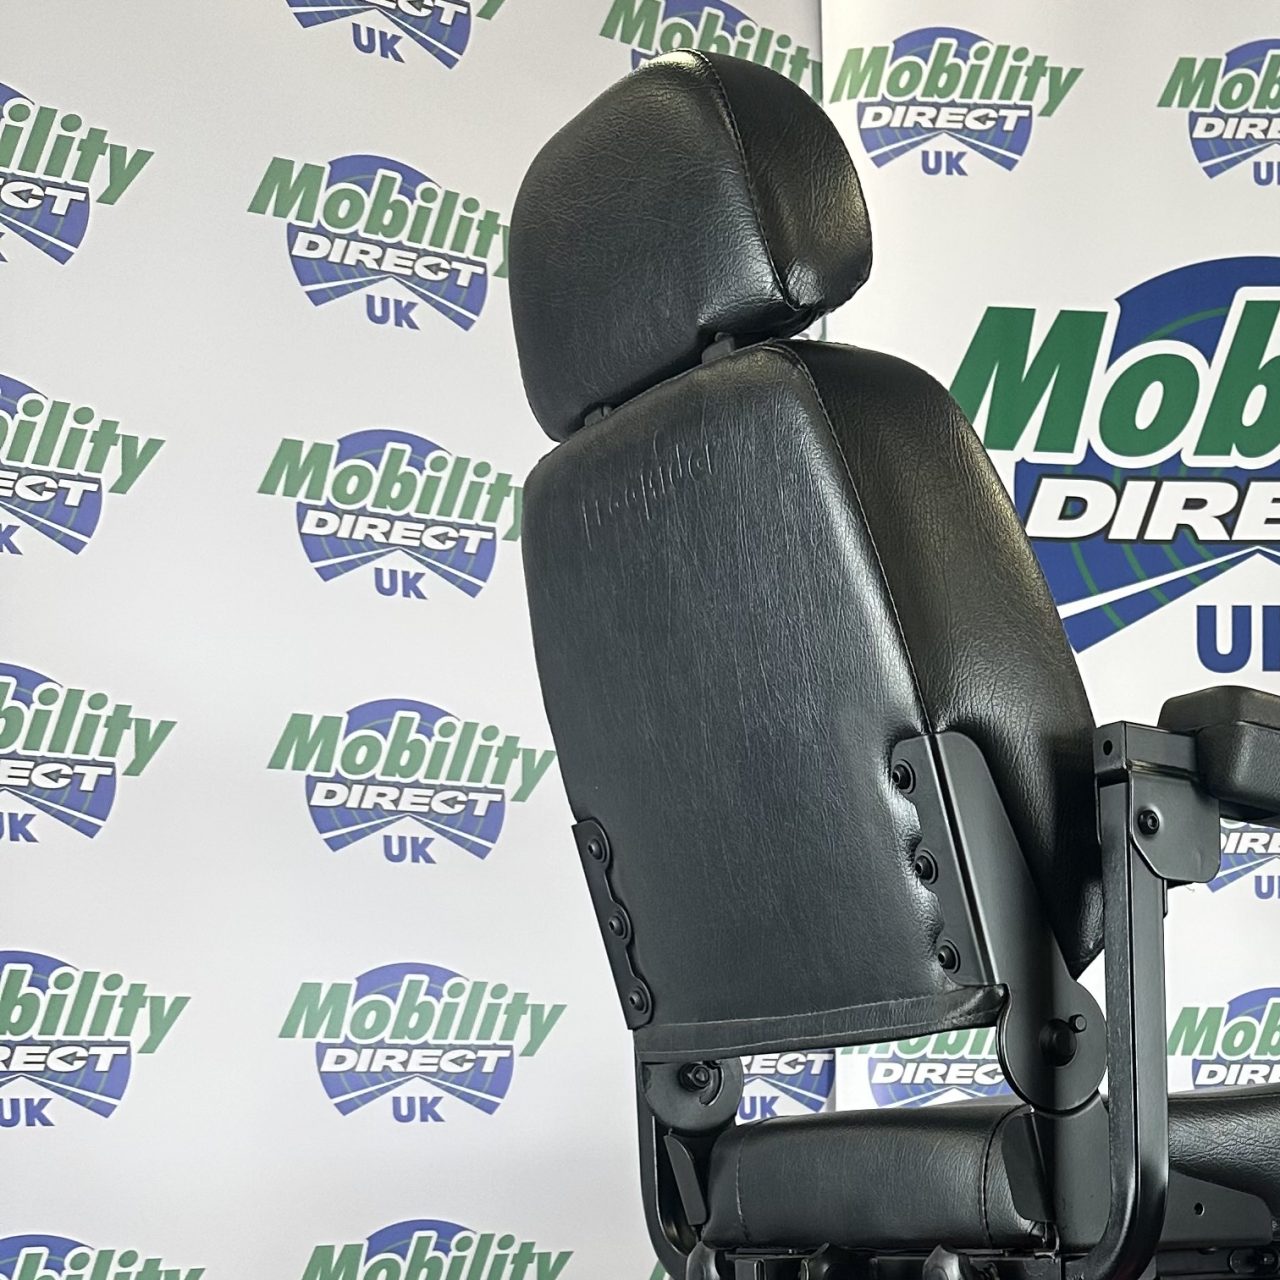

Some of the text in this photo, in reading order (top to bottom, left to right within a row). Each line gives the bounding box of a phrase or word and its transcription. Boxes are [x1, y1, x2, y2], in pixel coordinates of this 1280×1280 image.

[352, 22, 405, 63] UK
[831, 41, 1083, 118] Mobility
[859, 105, 1030, 131] DIRECT
[0, 104, 155, 205] ility
[920, 149, 968, 176] UK
[291, 234, 485, 287] DIRECT
[366, 294, 420, 331] UK
[0, 399, 166, 494] ility
[301, 510, 494, 555] DIRECT
[374, 567, 428, 599] UK
[0, 682, 178, 776] bility
[267, 713, 557, 802] Mobility
[0, 760, 113, 791] ECT
[309, 783, 502, 816] DIRECT
[382, 835, 437, 864] UK
[0, 968, 192, 1054] bility
[277, 980, 567, 1056] Mobility
[319, 1049, 513, 1073] DIRECT
[872, 1063, 1005, 1085] DIREC
[0, 1098, 55, 1127] UK
[391, 1096, 445, 1123] UK
[739, 1096, 780, 1120] UK
